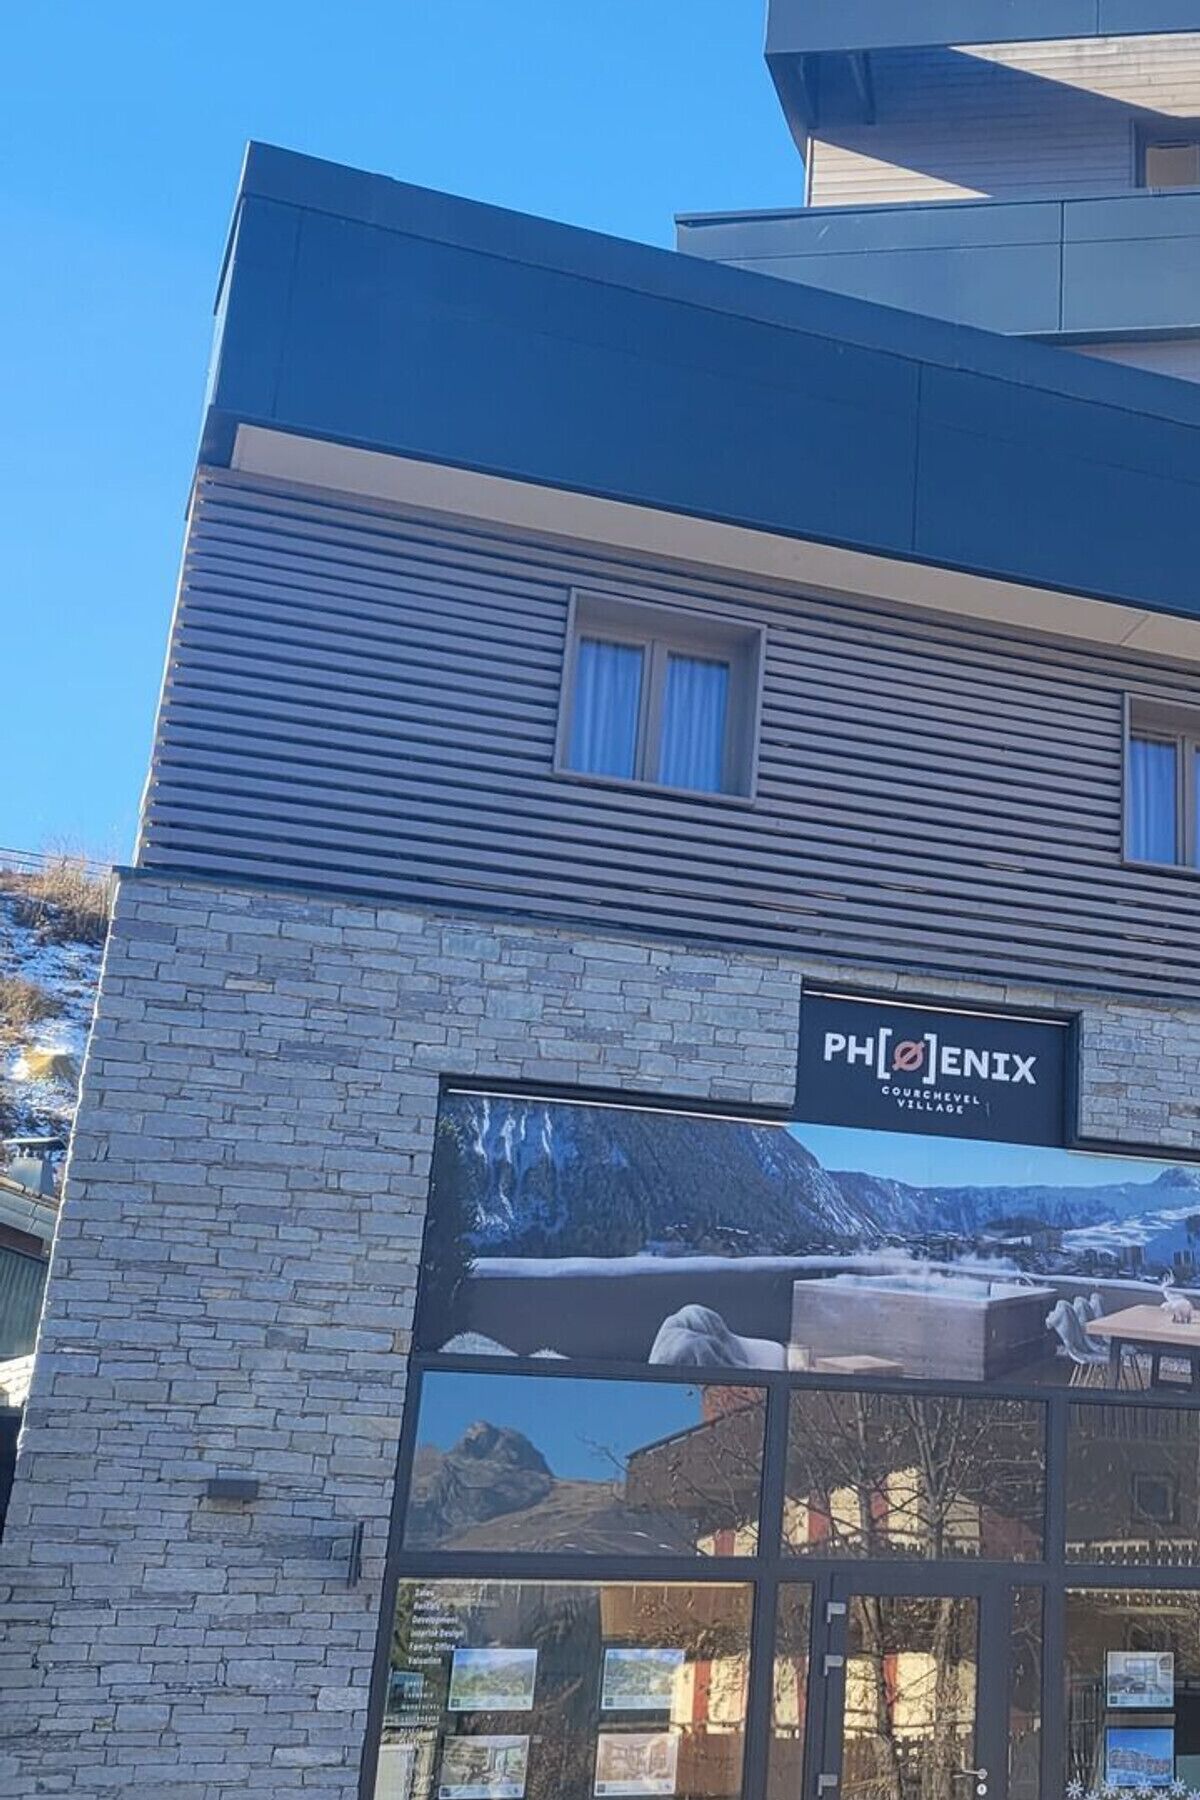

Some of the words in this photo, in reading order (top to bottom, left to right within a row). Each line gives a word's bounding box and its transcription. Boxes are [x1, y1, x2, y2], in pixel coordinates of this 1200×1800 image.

[881, 1086, 980, 1106] COURCHEVEL
[896, 1099, 965, 1115] VILLAGE
[411, 1615, 459, 1626] Development
